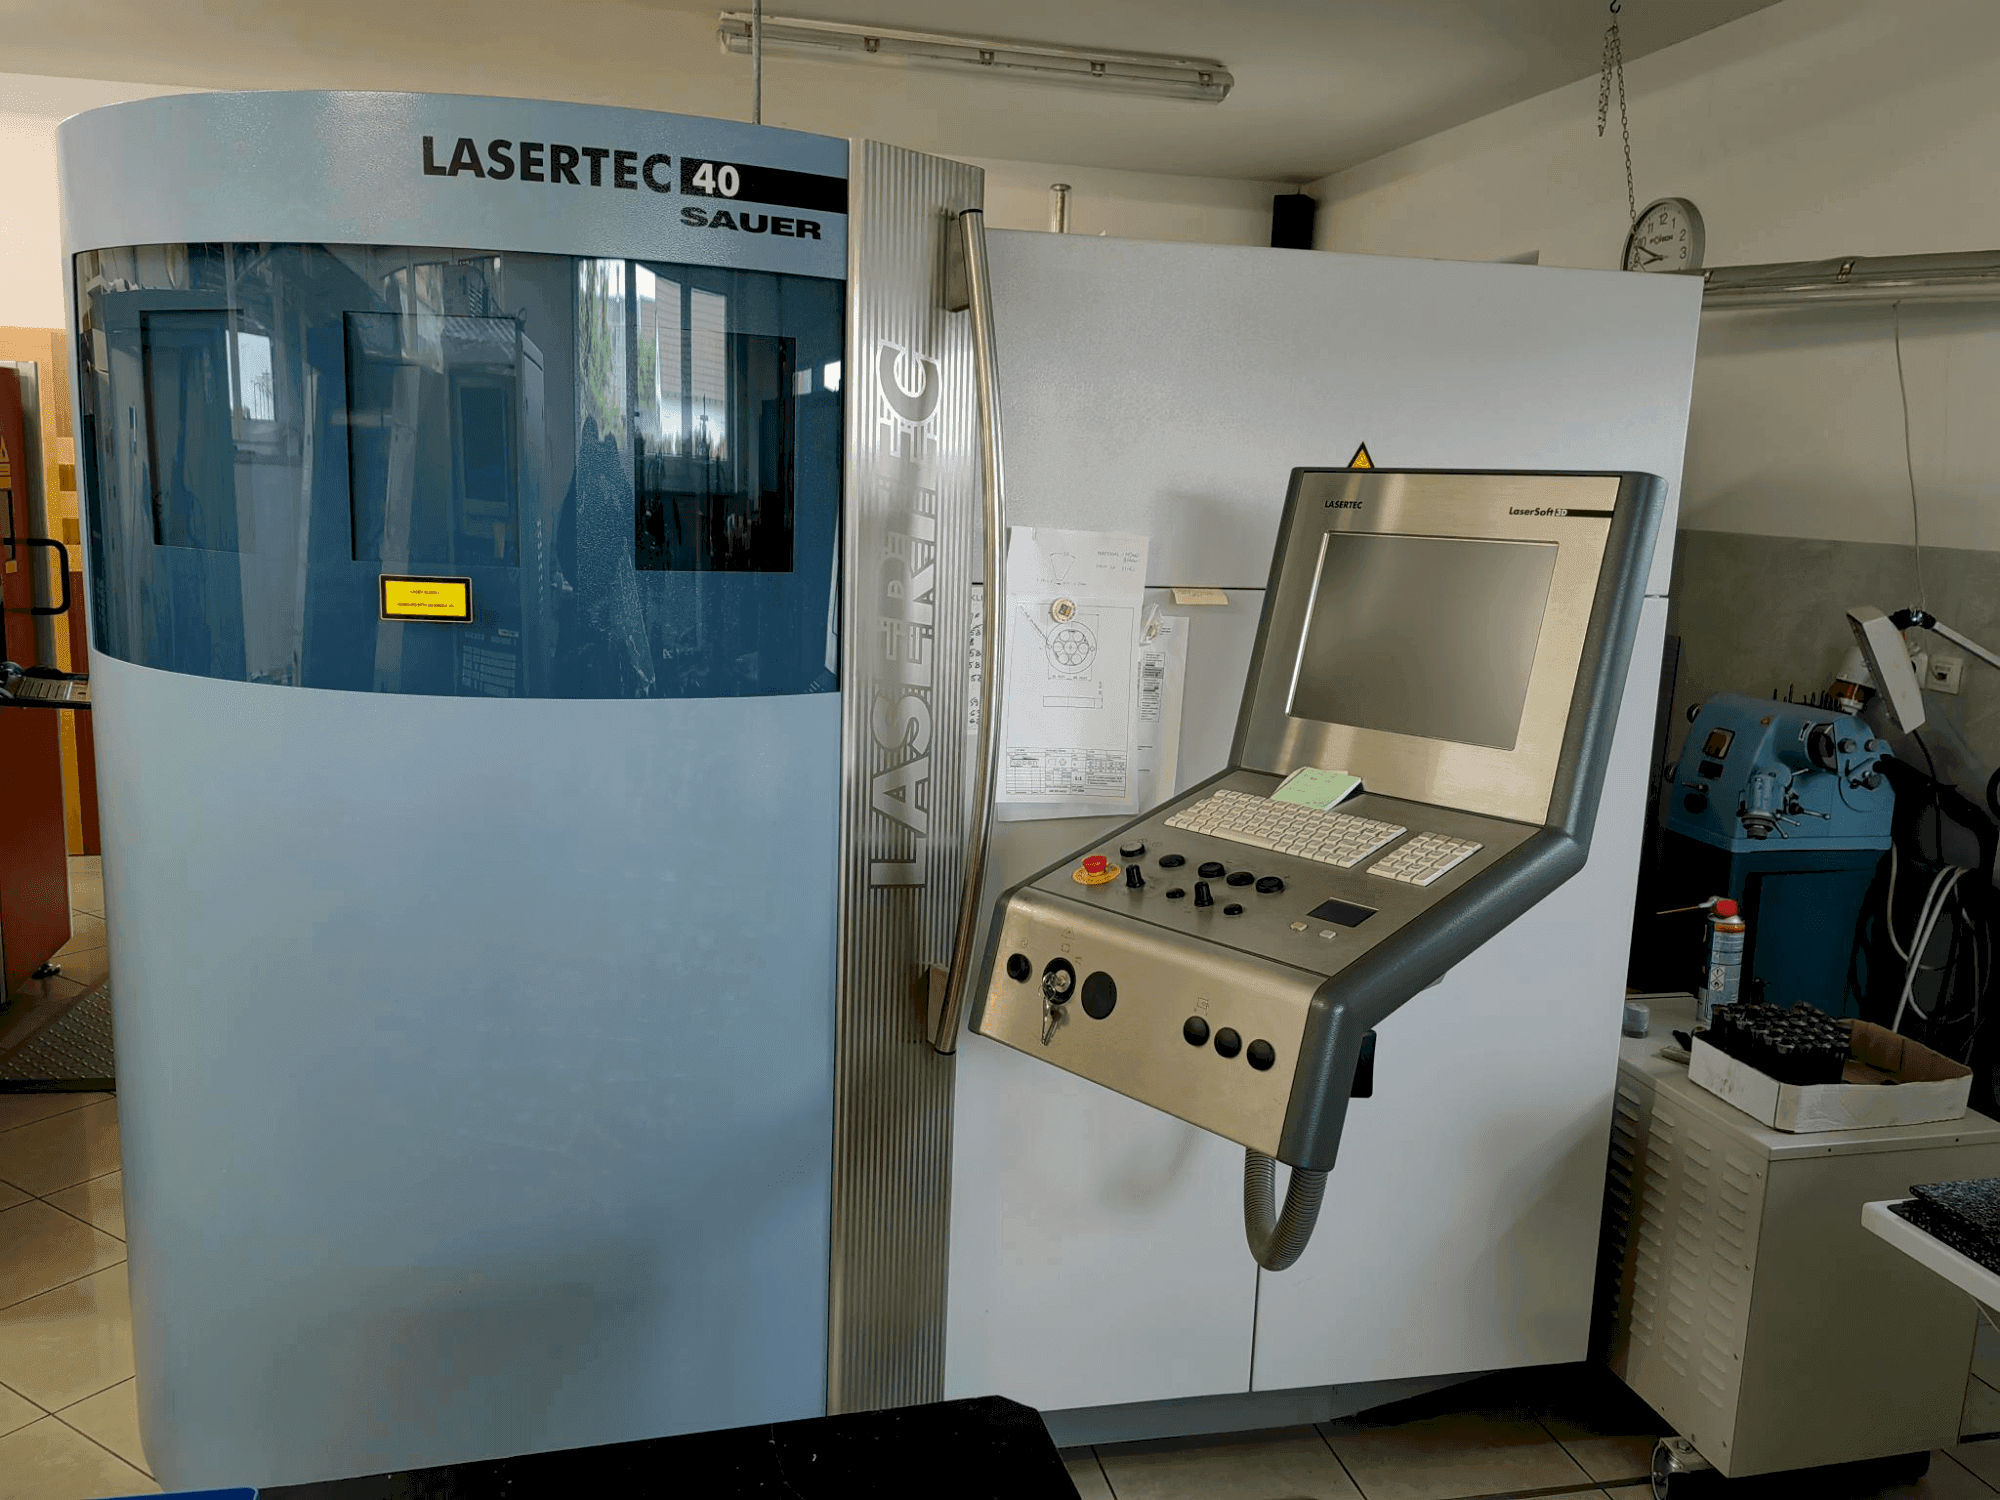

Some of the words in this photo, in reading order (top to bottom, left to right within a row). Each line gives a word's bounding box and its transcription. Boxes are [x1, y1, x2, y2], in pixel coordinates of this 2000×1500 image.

[422, 136, 671, 193] LASERTEC
[691, 162, 740, 197] 40
[680, 206, 822, 240] SAUER
[1660, 213, 1668, 225] 12
[1647, 222, 1654, 234] 11
[1680, 229, 1687, 241] 2
[1680, 246, 1687, 259] 3
[1324, 500, 1363, 510] LASERTEC
[1509, 506, 1554, 517] LaserSoft
[868, 337, 942, 888] LASERTEC
